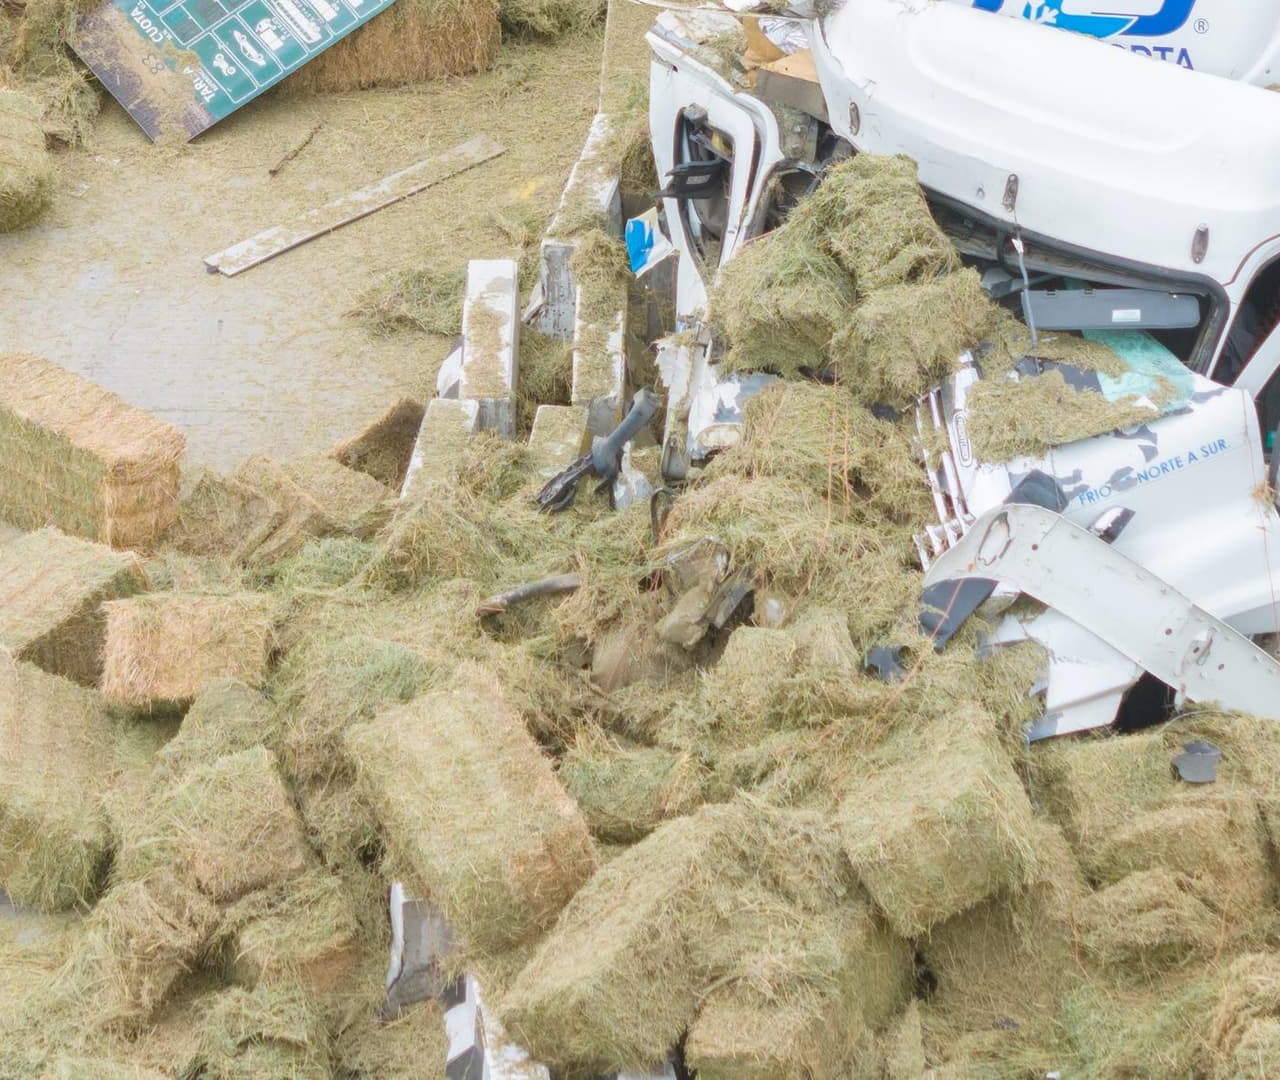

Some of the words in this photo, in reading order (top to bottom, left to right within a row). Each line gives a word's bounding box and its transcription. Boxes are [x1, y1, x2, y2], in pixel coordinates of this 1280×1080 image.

[130, 6, 163, 42] CUOTA
[1136, 455, 1185, 484] NORTE
[1187, 451, 1199, 465] A
